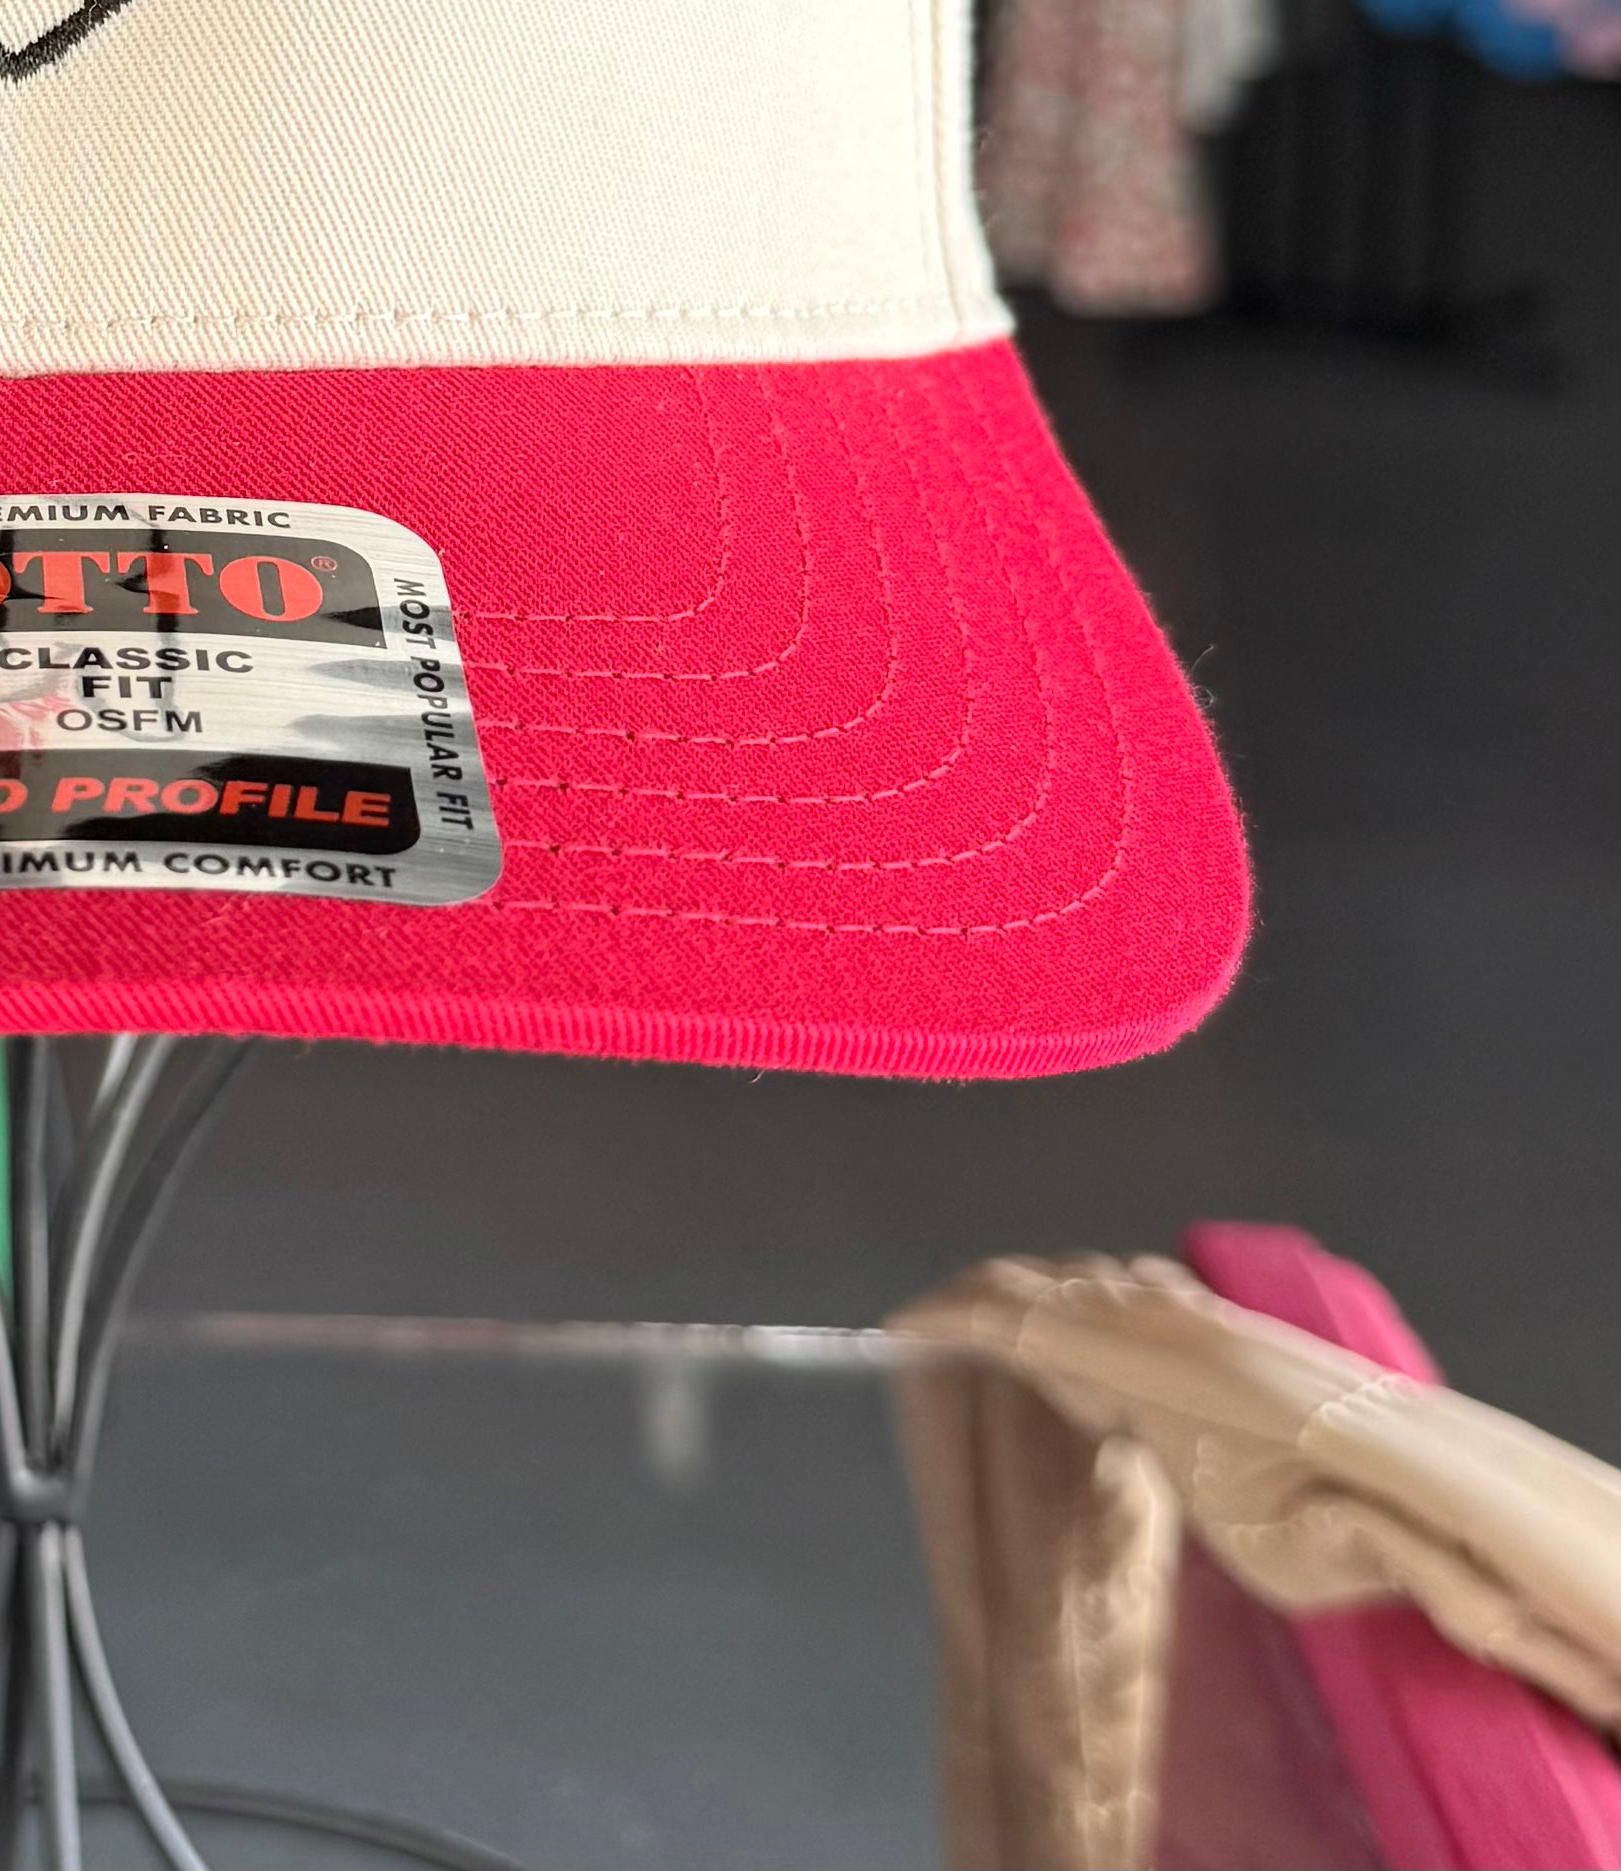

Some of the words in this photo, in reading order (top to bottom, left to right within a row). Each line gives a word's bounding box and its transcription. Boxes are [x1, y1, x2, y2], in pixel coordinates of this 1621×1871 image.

[148, 506, 292, 529] FABRIC
[393, 577, 437, 649] MOST
[82, 676, 173, 699] FIT
[56, 709, 204, 734] OSFM
[409, 655, 463, 781] POPULAR
[52, 778, 391, 827] PROFILE
[435, 790, 474, 830] FIT
[162, 852, 396, 888] COMFORT
